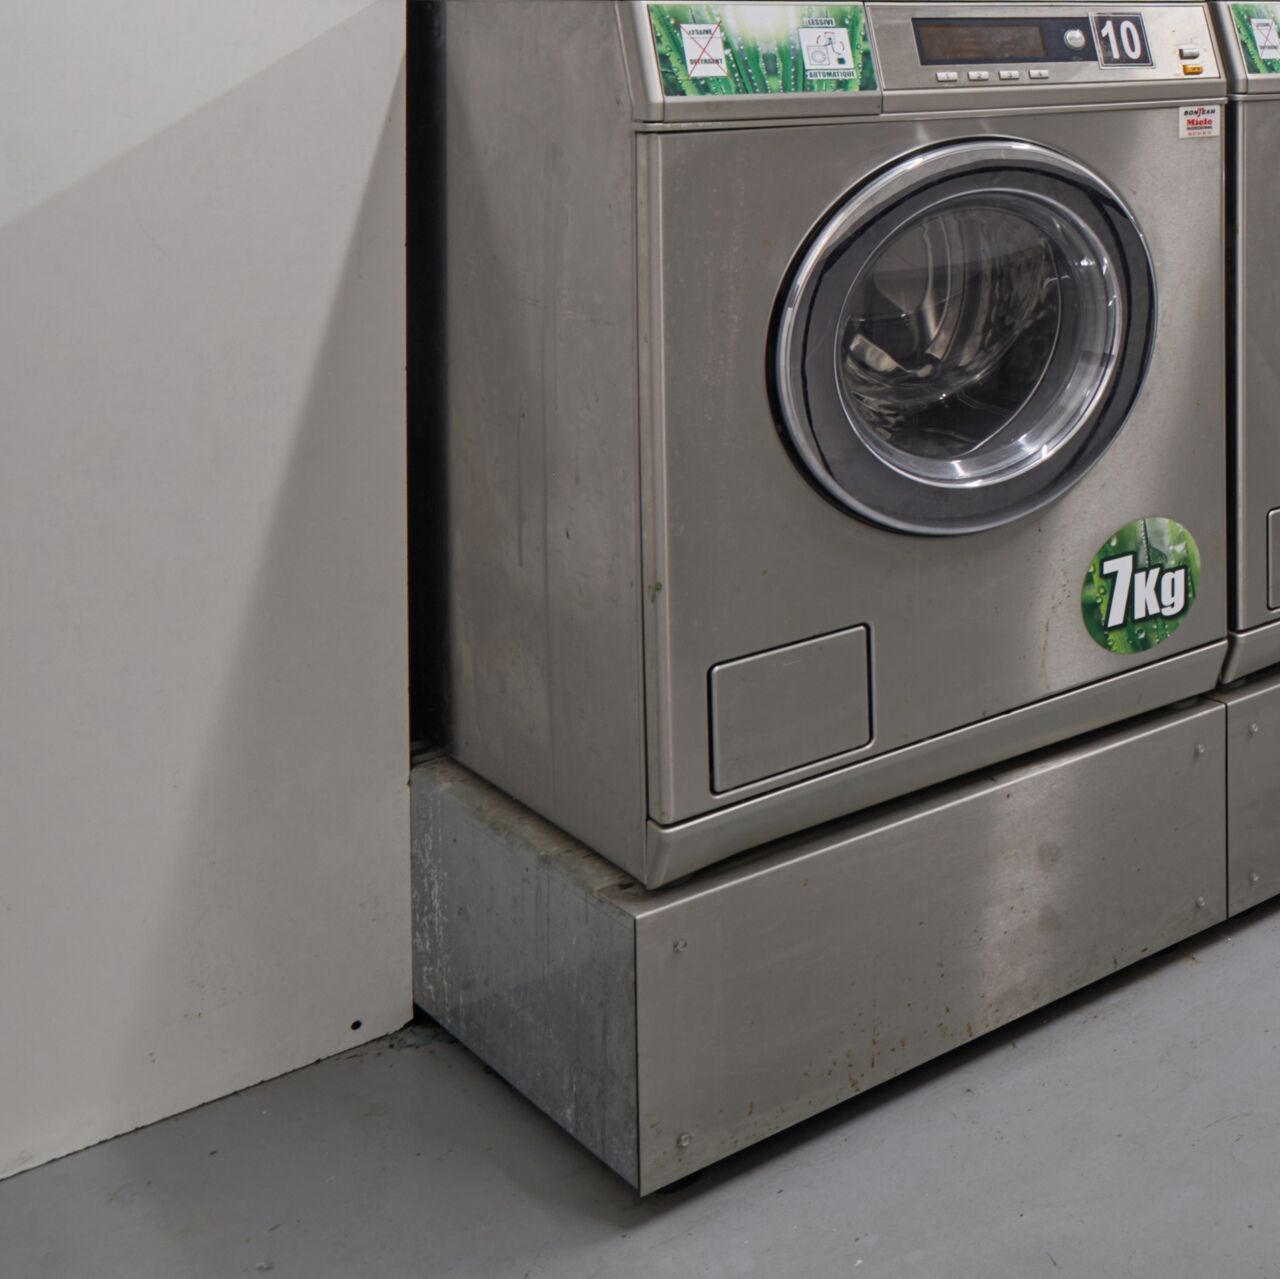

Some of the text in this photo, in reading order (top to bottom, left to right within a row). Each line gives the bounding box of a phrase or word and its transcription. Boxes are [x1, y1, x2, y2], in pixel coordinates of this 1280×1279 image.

[1101, 19, 1142, 61] 10
[1186, 118, 1213, 126] Miele
[1103, 554, 1185, 629] 7Kg
